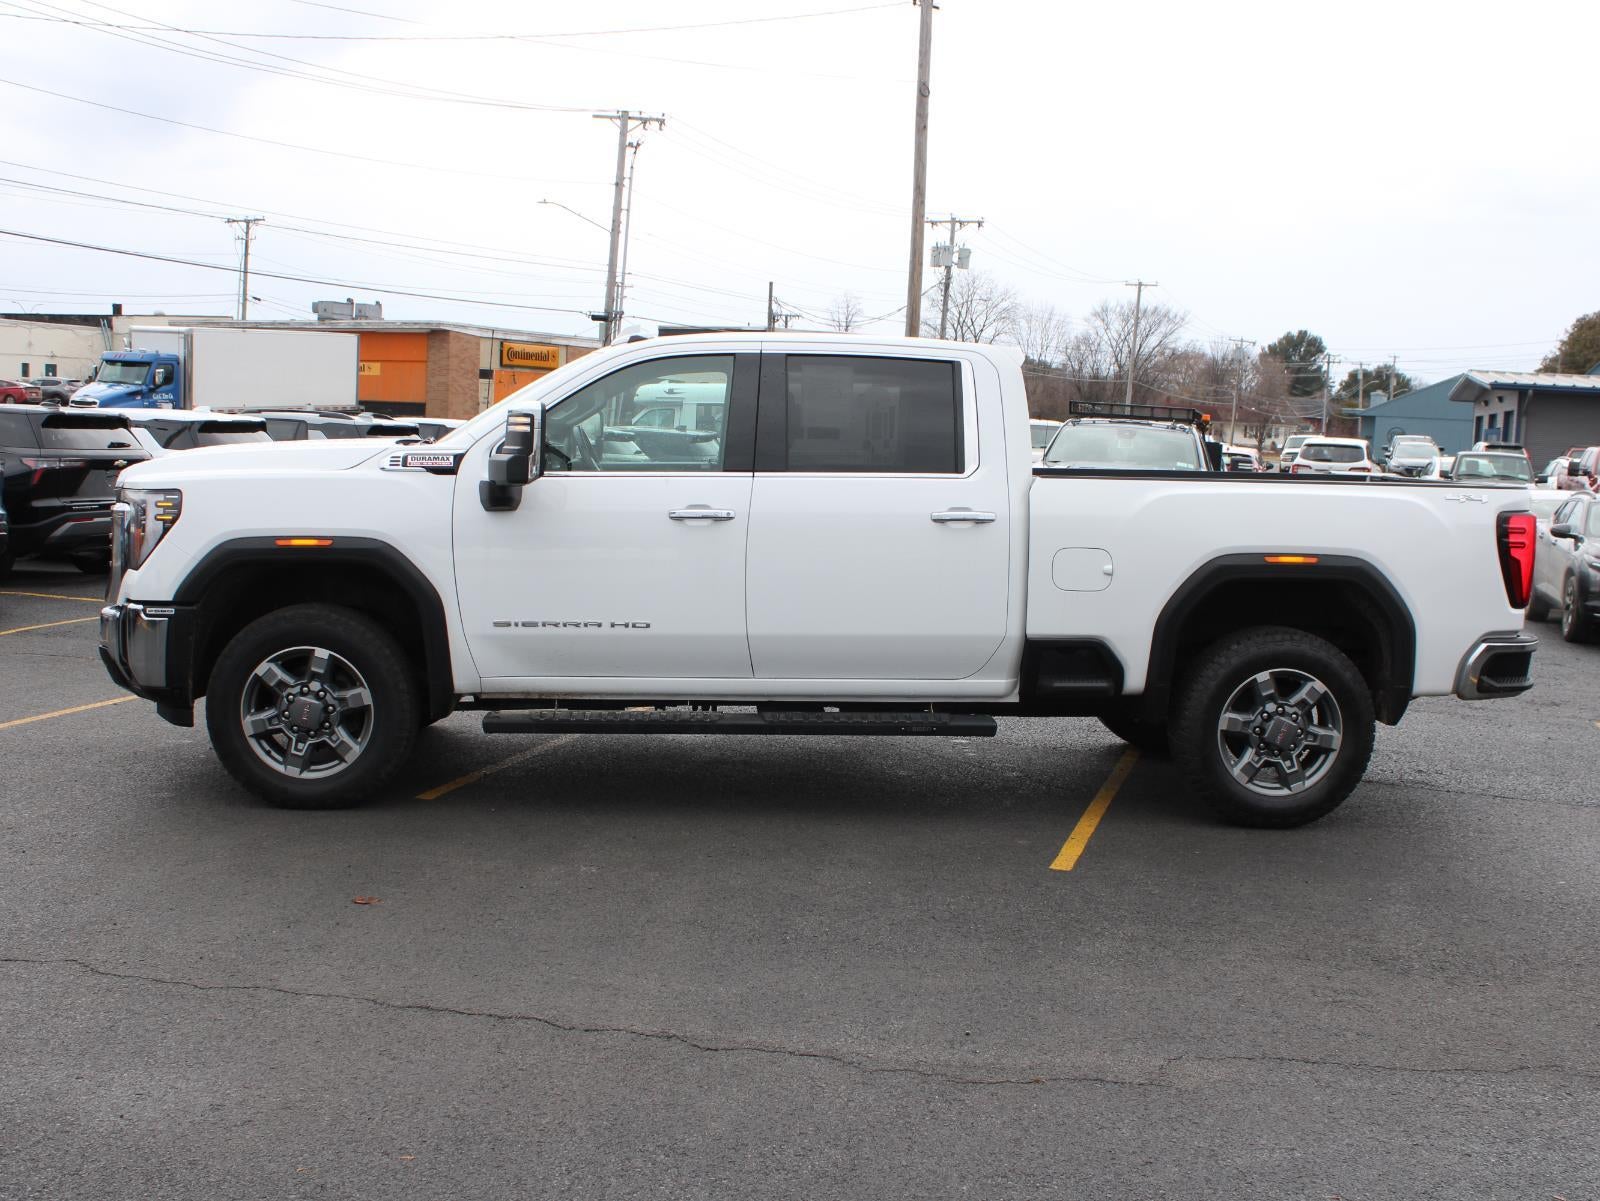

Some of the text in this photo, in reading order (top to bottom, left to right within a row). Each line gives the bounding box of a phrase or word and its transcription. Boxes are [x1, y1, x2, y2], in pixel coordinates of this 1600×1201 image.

[506, 346, 551, 362] Continental
[492, 620, 651, 629] SIERRA HD
